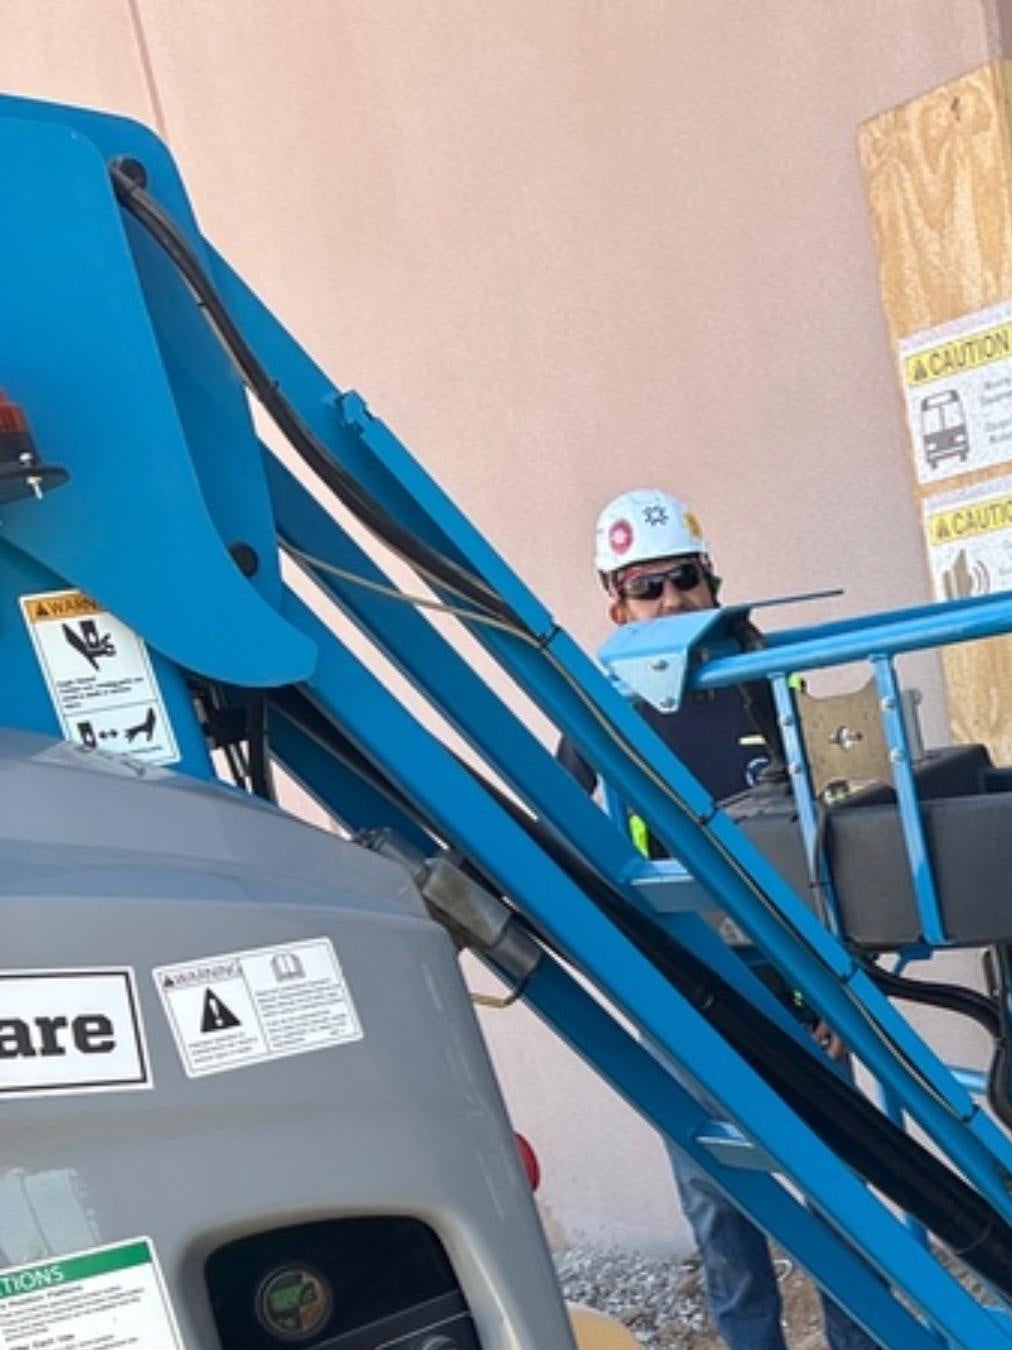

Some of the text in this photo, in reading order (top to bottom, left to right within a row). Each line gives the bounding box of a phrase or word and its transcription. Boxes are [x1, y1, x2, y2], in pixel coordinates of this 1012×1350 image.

[928, 331, 1011, 378] CAUTION
[174, 958, 243, 986] WARNING
[0, 1013, 116, 1058] are
[3, 1265, 65, 1295] TIONS
